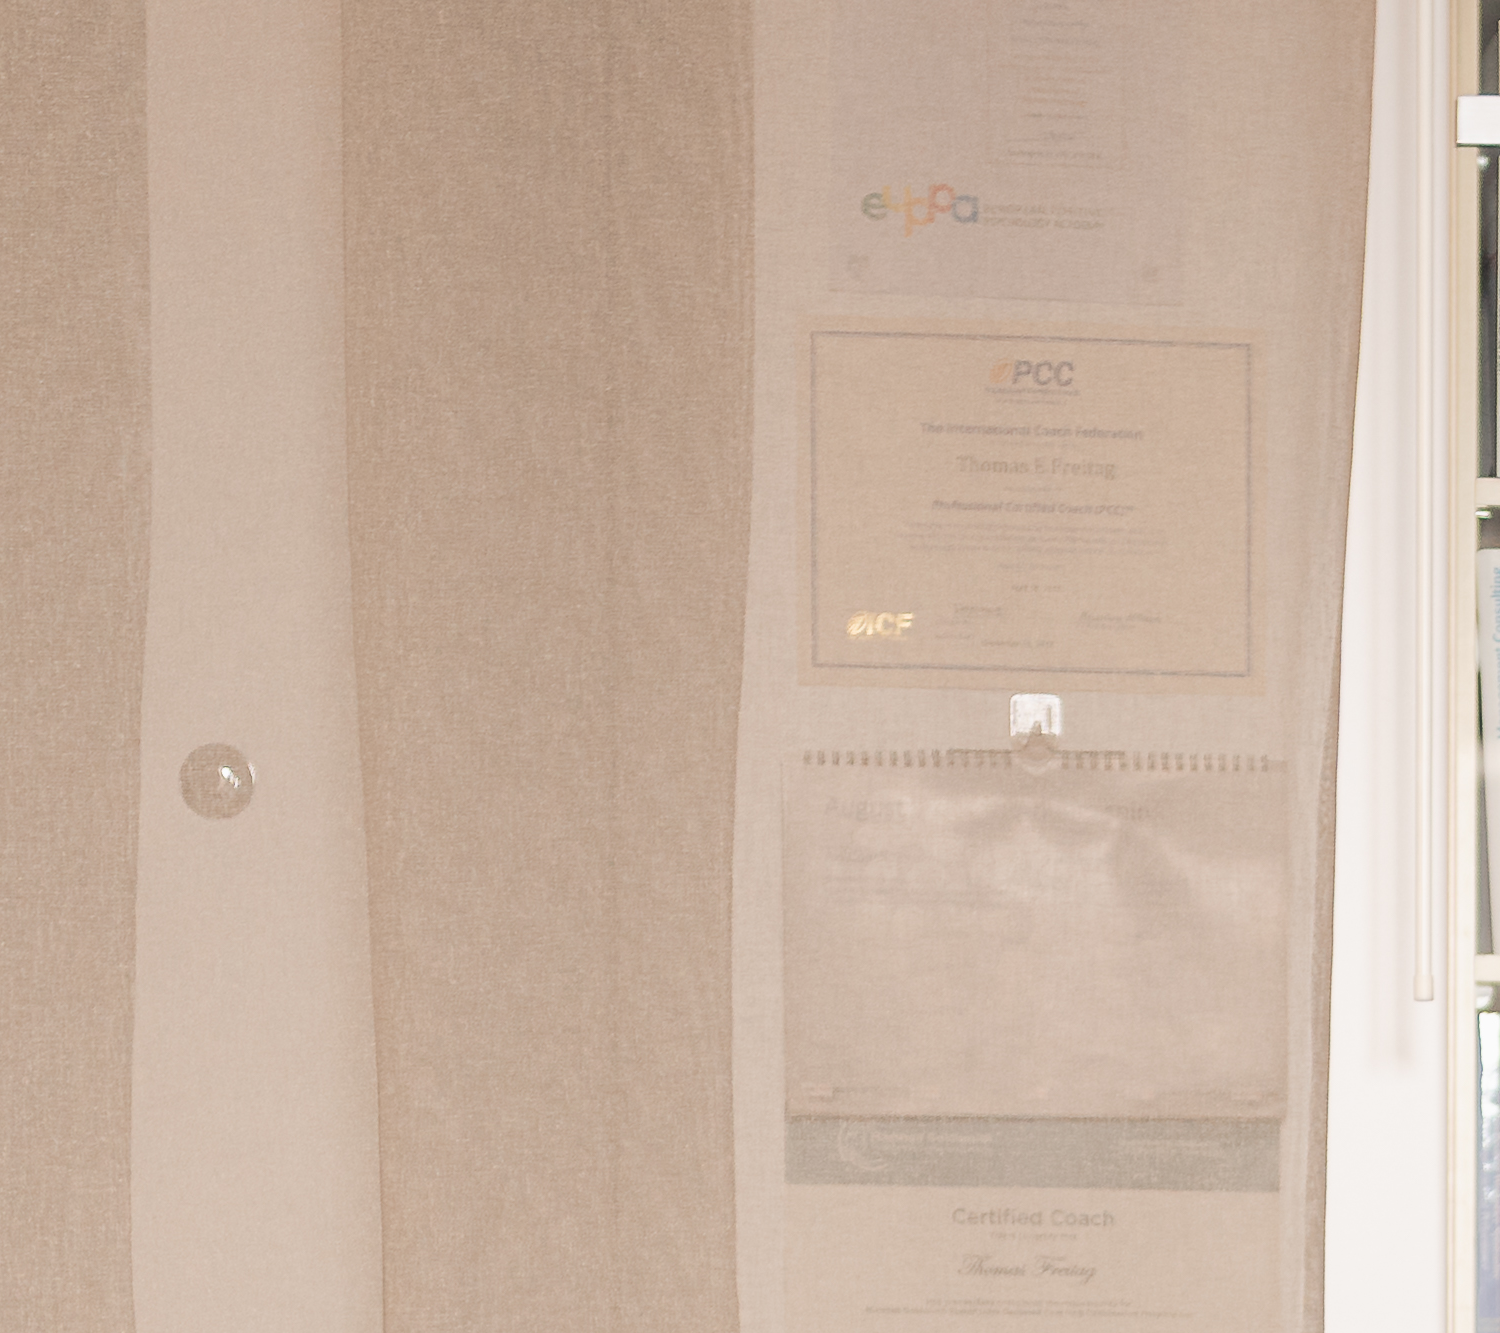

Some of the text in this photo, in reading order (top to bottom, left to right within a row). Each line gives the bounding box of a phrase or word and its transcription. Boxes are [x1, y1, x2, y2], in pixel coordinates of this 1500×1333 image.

[1012, 360, 1076, 387] PCC
[956, 454, 1030, 476] Thomas
[952, 1207, 1117, 1229] Certified Coach
